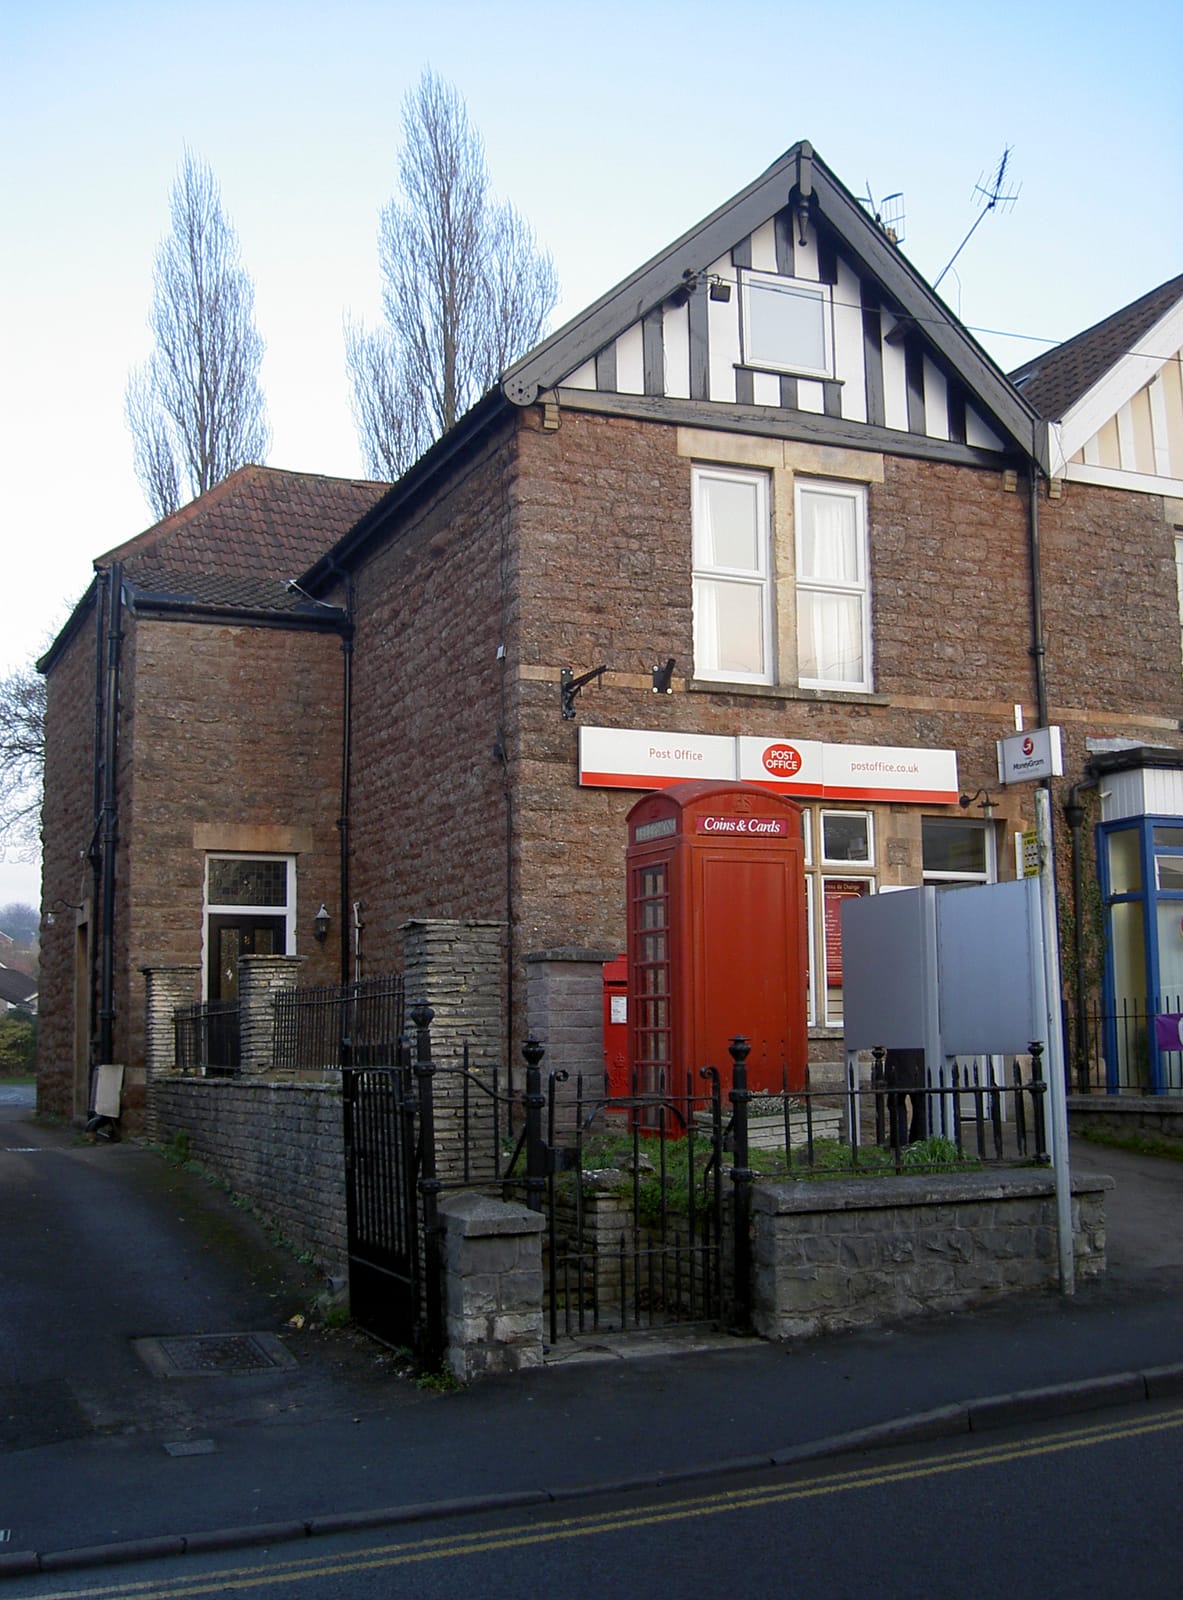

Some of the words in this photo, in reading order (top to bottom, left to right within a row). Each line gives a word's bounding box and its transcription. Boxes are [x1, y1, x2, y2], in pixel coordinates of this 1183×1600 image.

[649, 747, 671, 759] Post
[674, 749, 703, 761] Office
[771, 750, 795, 761] POST
[766, 759, 798, 770] OFFICE
[851, 761, 919, 773] postoffice.co.uk
[1013, 759, 1045, 771] MoneyGram
[704, 817, 736, 831] Coins
[736, 819, 747, 832] &
[748, 818, 781, 833] Cards
